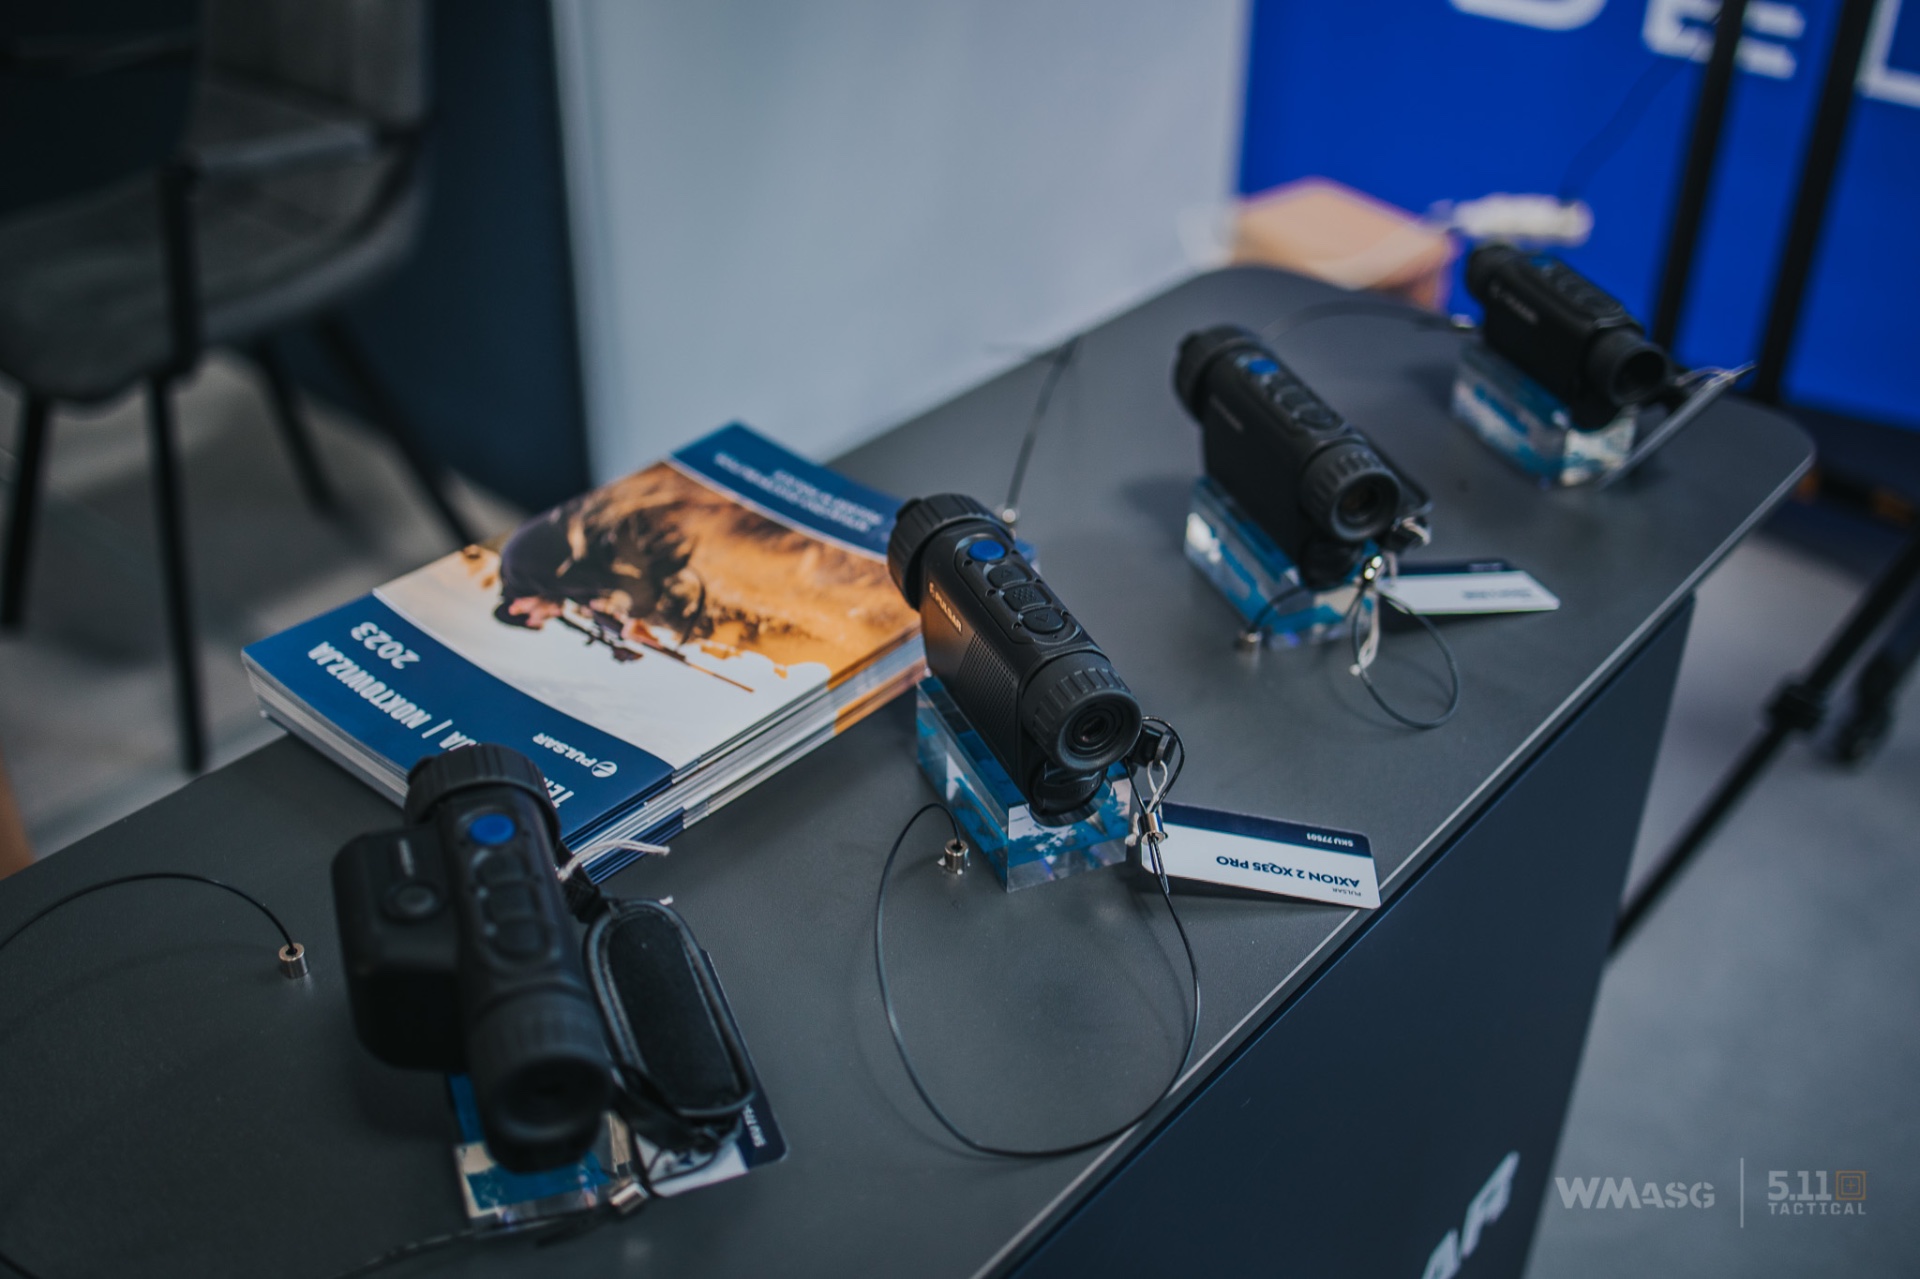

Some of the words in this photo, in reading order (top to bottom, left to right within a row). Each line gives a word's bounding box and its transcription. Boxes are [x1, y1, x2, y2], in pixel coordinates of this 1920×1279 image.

[350, 622, 420, 669] 2023
[308, 642, 431, 729] NOKTOWIZJA
[532, 732, 599, 767] PULSAR
[1333, 837, 1354, 847] SKU
[1216, 856, 1249, 869] PRO
[1252, 862, 1293, 877] XQ35
[1296, 869, 1305, 878] 2
[1309, 871, 1360, 888] AXION
